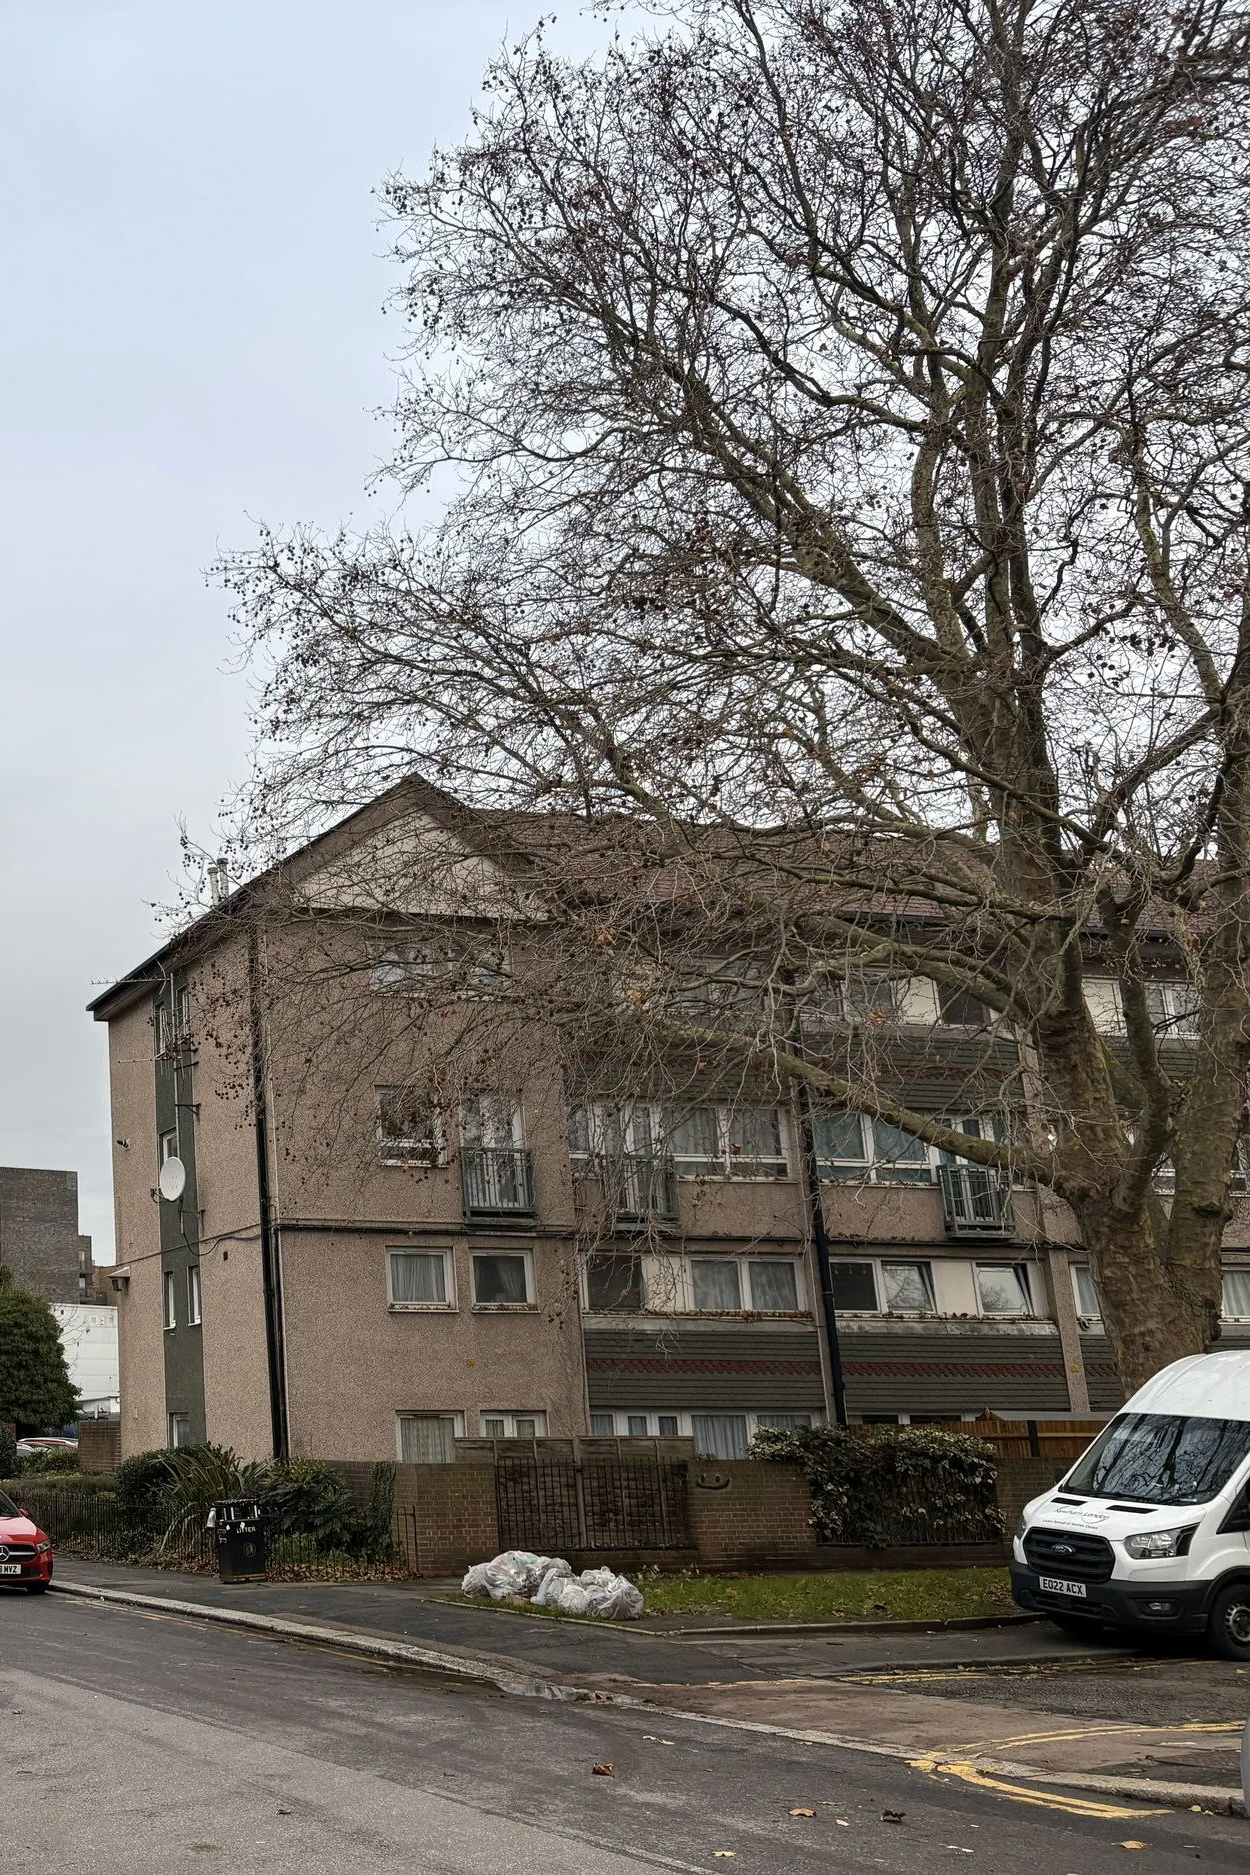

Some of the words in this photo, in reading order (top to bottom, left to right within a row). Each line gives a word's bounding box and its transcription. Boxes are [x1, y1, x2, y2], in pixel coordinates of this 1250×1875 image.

[236, 1526, 256, 1534] LITTER
[4, 1565, 17, 1573] MVZ
[1042, 1578, 1065, 1592] EO22
[1066, 1582, 1083, 1595] ACX
